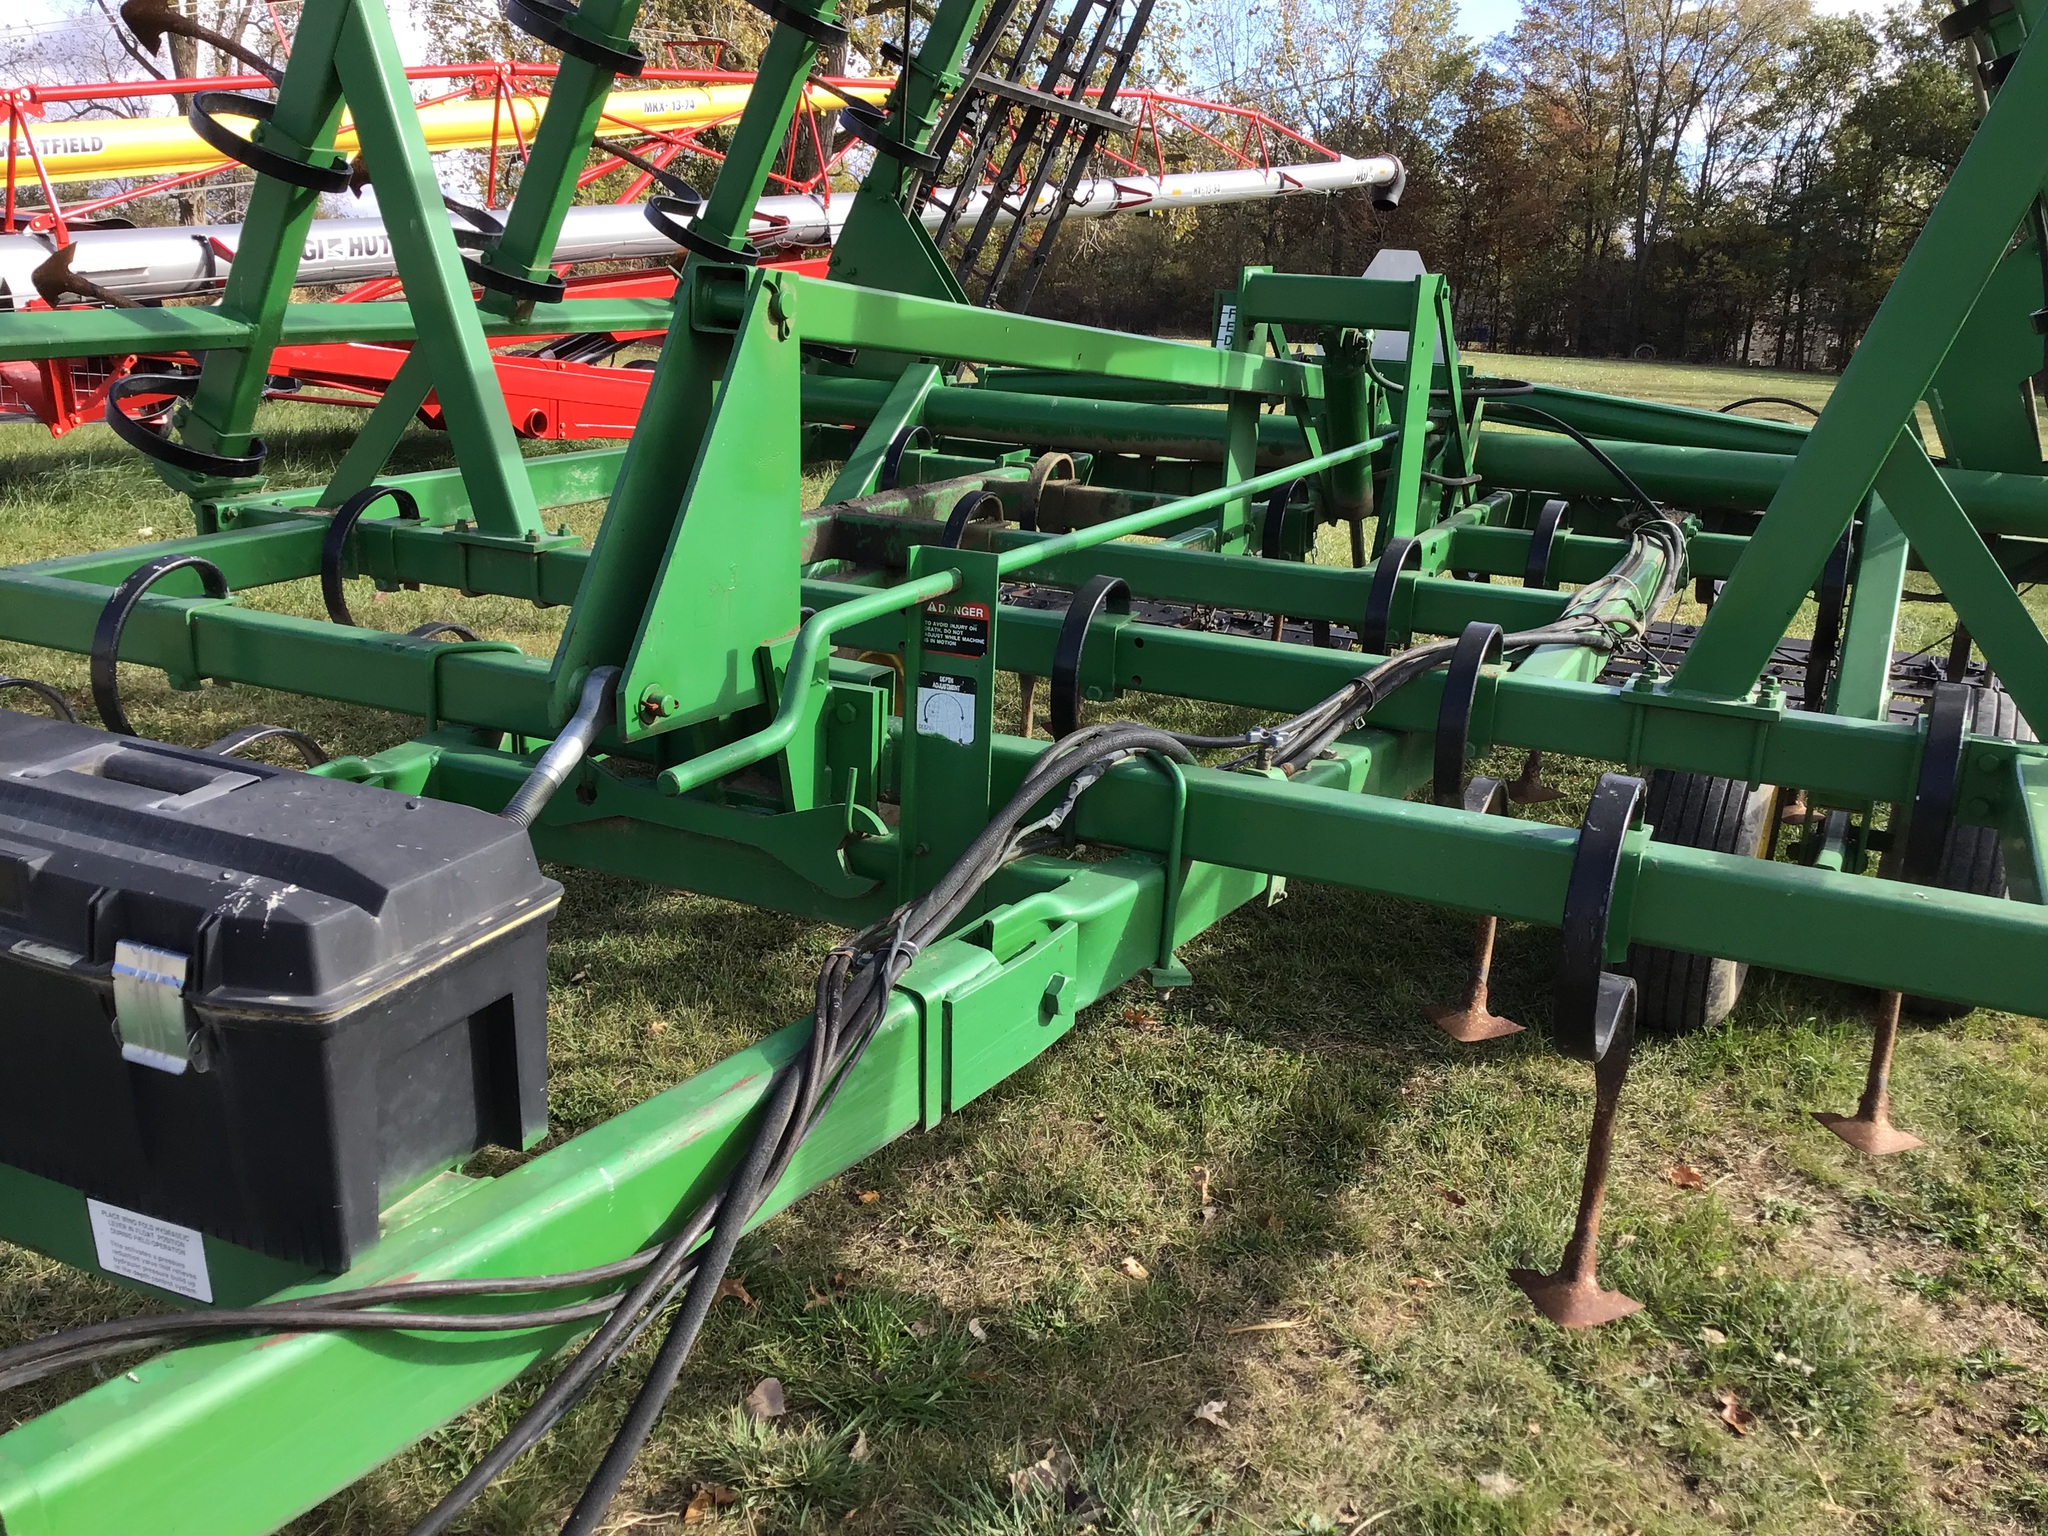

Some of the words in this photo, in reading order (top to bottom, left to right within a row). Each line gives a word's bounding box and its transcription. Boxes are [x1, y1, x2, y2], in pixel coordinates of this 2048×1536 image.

[938, 603, 984, 618] DANGER
[944, 634, 961, 642] WHILE
[961, 636, 985, 645] MACHINE
[931, 681, 961, 692] ADJUSTMENT
[939, 675, 955, 684] DEPTH
[101, 1209, 120, 1220] PLACE
[121, 1216, 138, 1226] WING
[138, 1220, 154, 1230] FOLD
[155, 1226, 190, 1241] HYDRAULIC
[108, 1219, 127, 1229] LEVER
[135, 1228, 155, 1237] FLOAT
[156, 1234, 185, 1248] POSITION
[110, 1227, 133, 1239] DURING
[133, 1234, 151, 1245] FIELD
[150, 1240, 186, 1255] OPERATION
[158, 1255, 186, 1269] pressure
